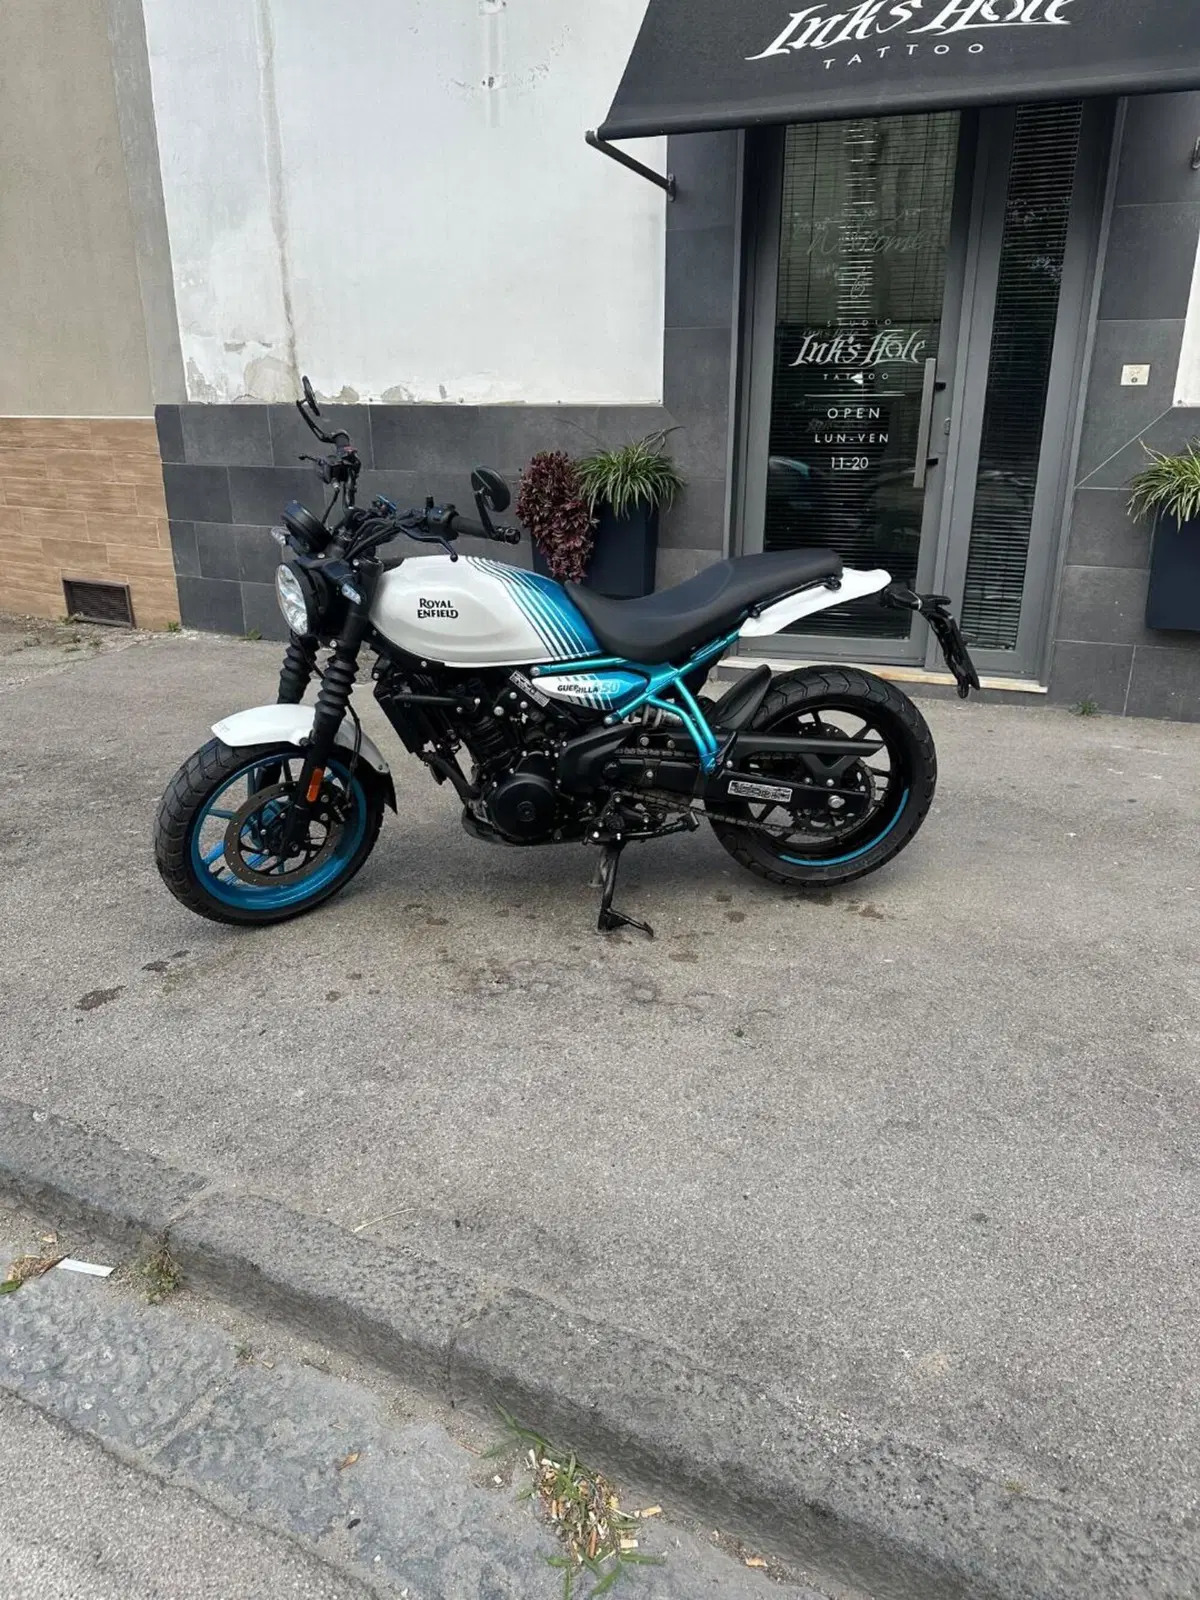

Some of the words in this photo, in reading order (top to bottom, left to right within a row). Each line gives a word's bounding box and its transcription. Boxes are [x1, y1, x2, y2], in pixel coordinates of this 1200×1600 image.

[744, 0, 924, 60] Inks
[822, 43, 985, 70] TATTOO
[826, 318, 892, 327] STUDIO
[788, 332, 862, 367] Ink's
[858, 329, 926, 368] Hole
[822, 372, 889, 380] TATOO
[827, 407, 880, 419] OPEN
[814, 433, 889, 443] LUN-VEN
[831, 456, 869, 470] 11-20
[419, 597, 454, 609] ROYAL
[417, 609, 459, 619] ENFIELD
